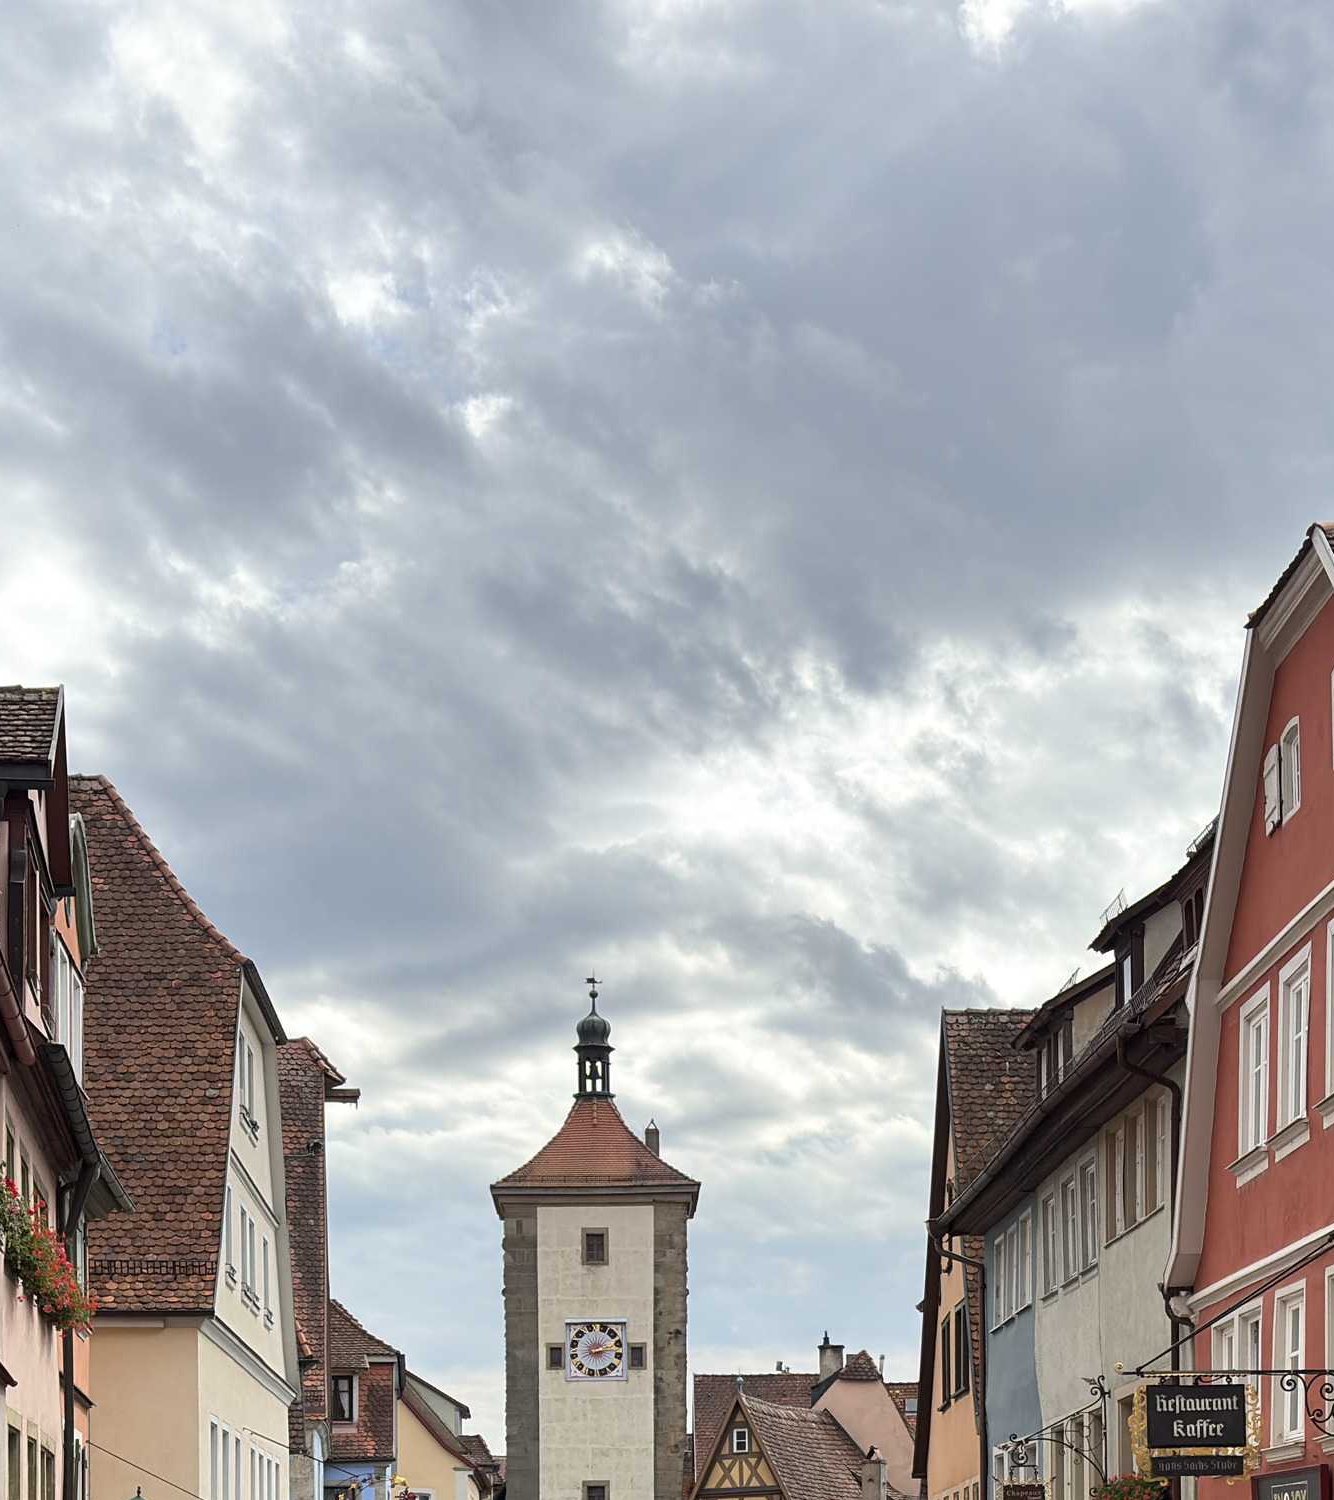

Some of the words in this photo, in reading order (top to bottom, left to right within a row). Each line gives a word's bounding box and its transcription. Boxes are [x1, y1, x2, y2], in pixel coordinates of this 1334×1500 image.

[1155, 1394, 1239, 1415] Restaurant
[1173, 1419, 1225, 1439] Kaffee
[1210, 1459, 1239, 1471] Stube
[1006, 1489, 1042, 1498] Chapeaux
